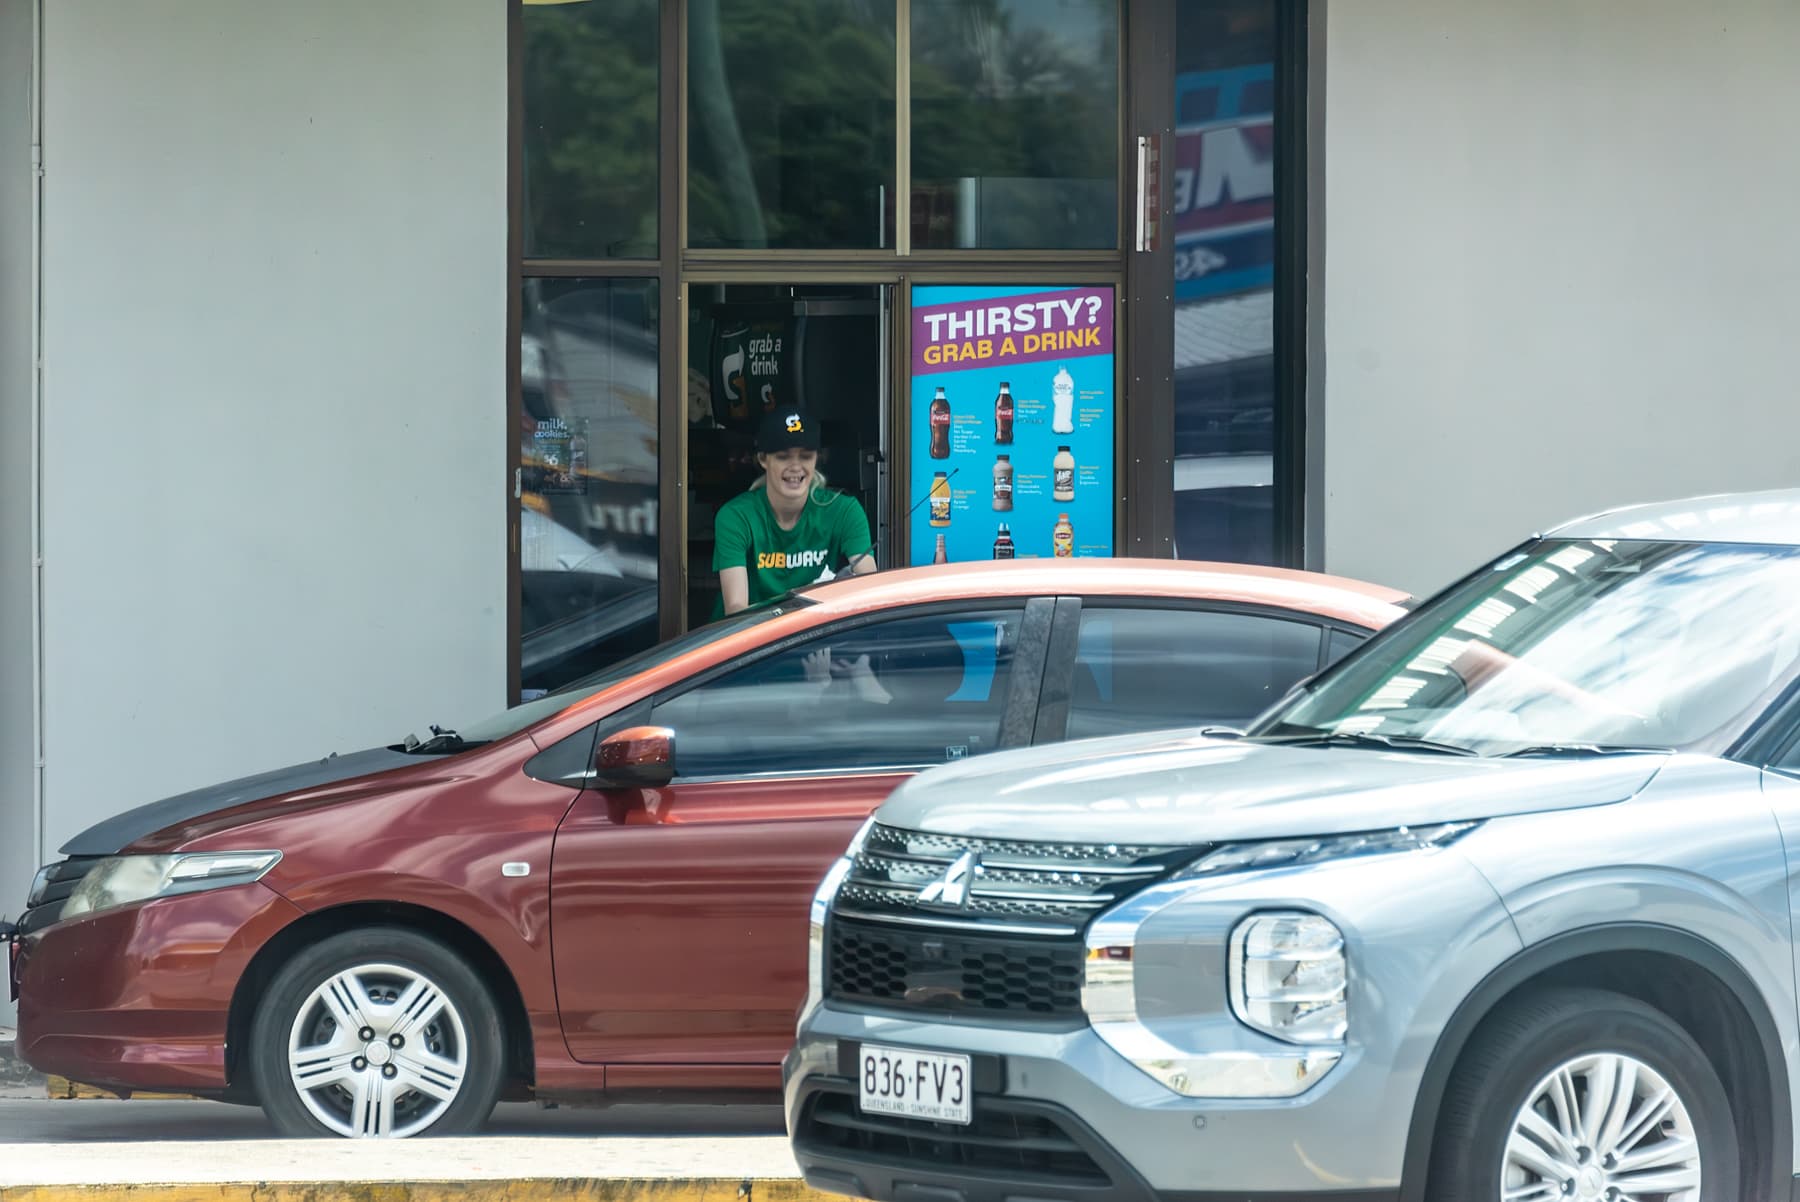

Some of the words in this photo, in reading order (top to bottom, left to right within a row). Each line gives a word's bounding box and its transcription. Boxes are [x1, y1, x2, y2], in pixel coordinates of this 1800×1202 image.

[923, 296, 1102, 342] THIRSTY?
[749, 334, 773, 358] grab
[774, 338, 782, 353] a
[923, 339, 993, 365] GRAB
[999, 337, 1017, 357] A
[1024, 327, 1101, 354] DRINK
[751, 356, 778, 376] drink
[757, 549, 828, 569] SUBWAY
